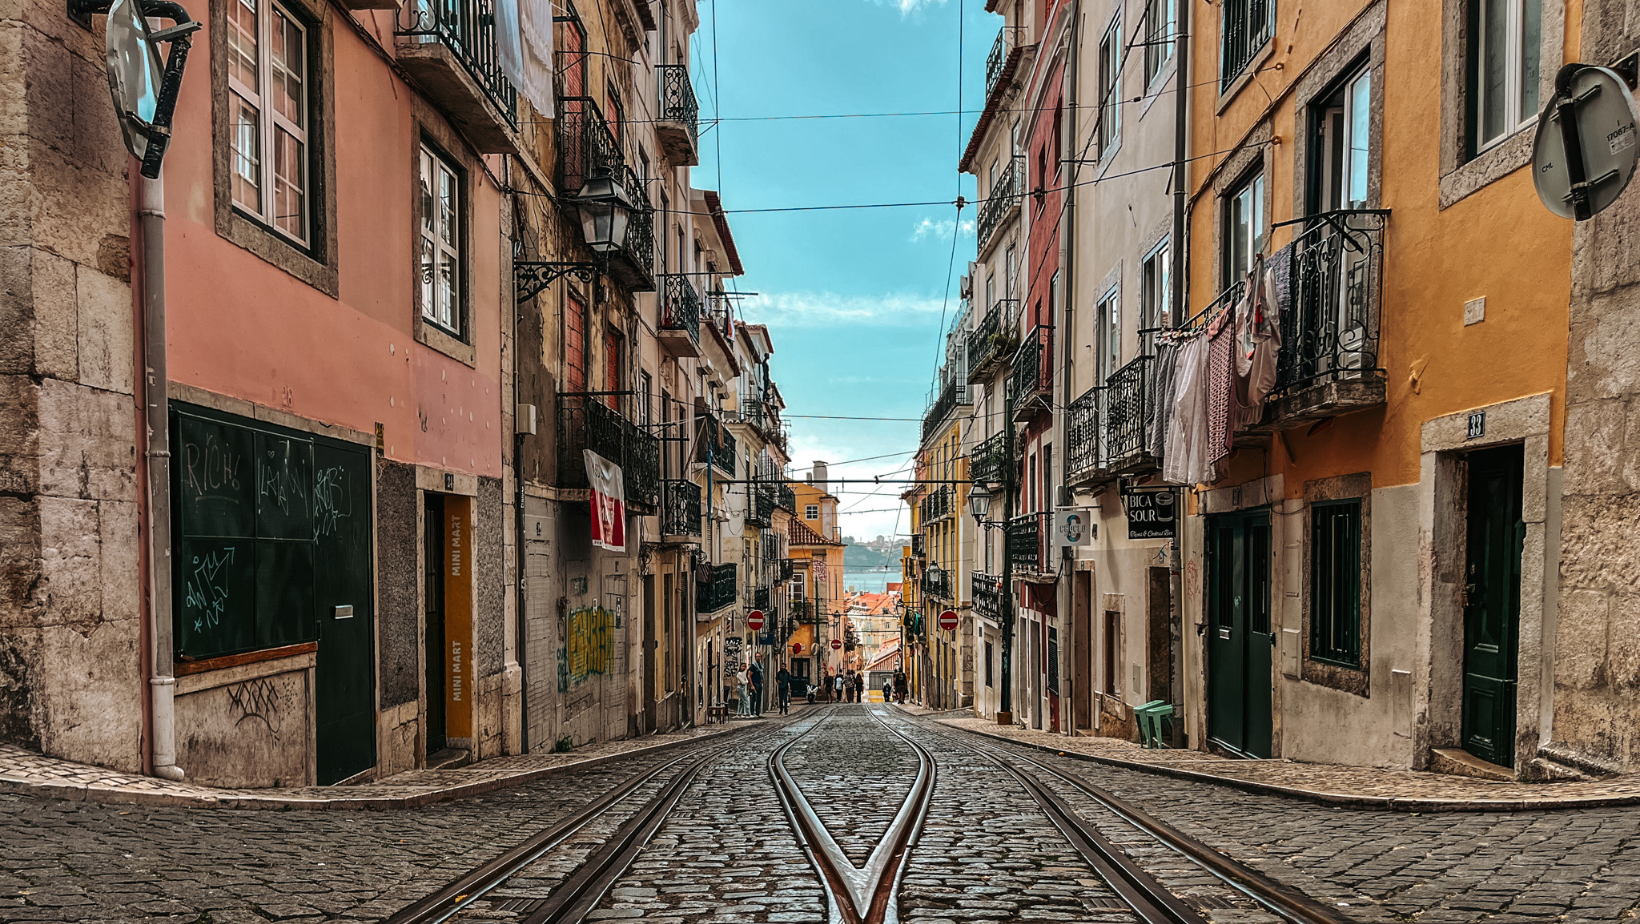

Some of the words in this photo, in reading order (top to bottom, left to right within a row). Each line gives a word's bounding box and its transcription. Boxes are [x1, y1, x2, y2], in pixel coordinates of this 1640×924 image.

[1541, 161, 1554, 173] CML
[1470, 414, 1482, 436] 33
[1130, 496, 1152, 507] BICA
[1130, 510, 1155, 522] SOUR
[452, 515, 460, 547] MART
[452, 550, 460, 576] MINI
[453, 641, 461, 673] MART
[453, 676, 461, 701] MINI
